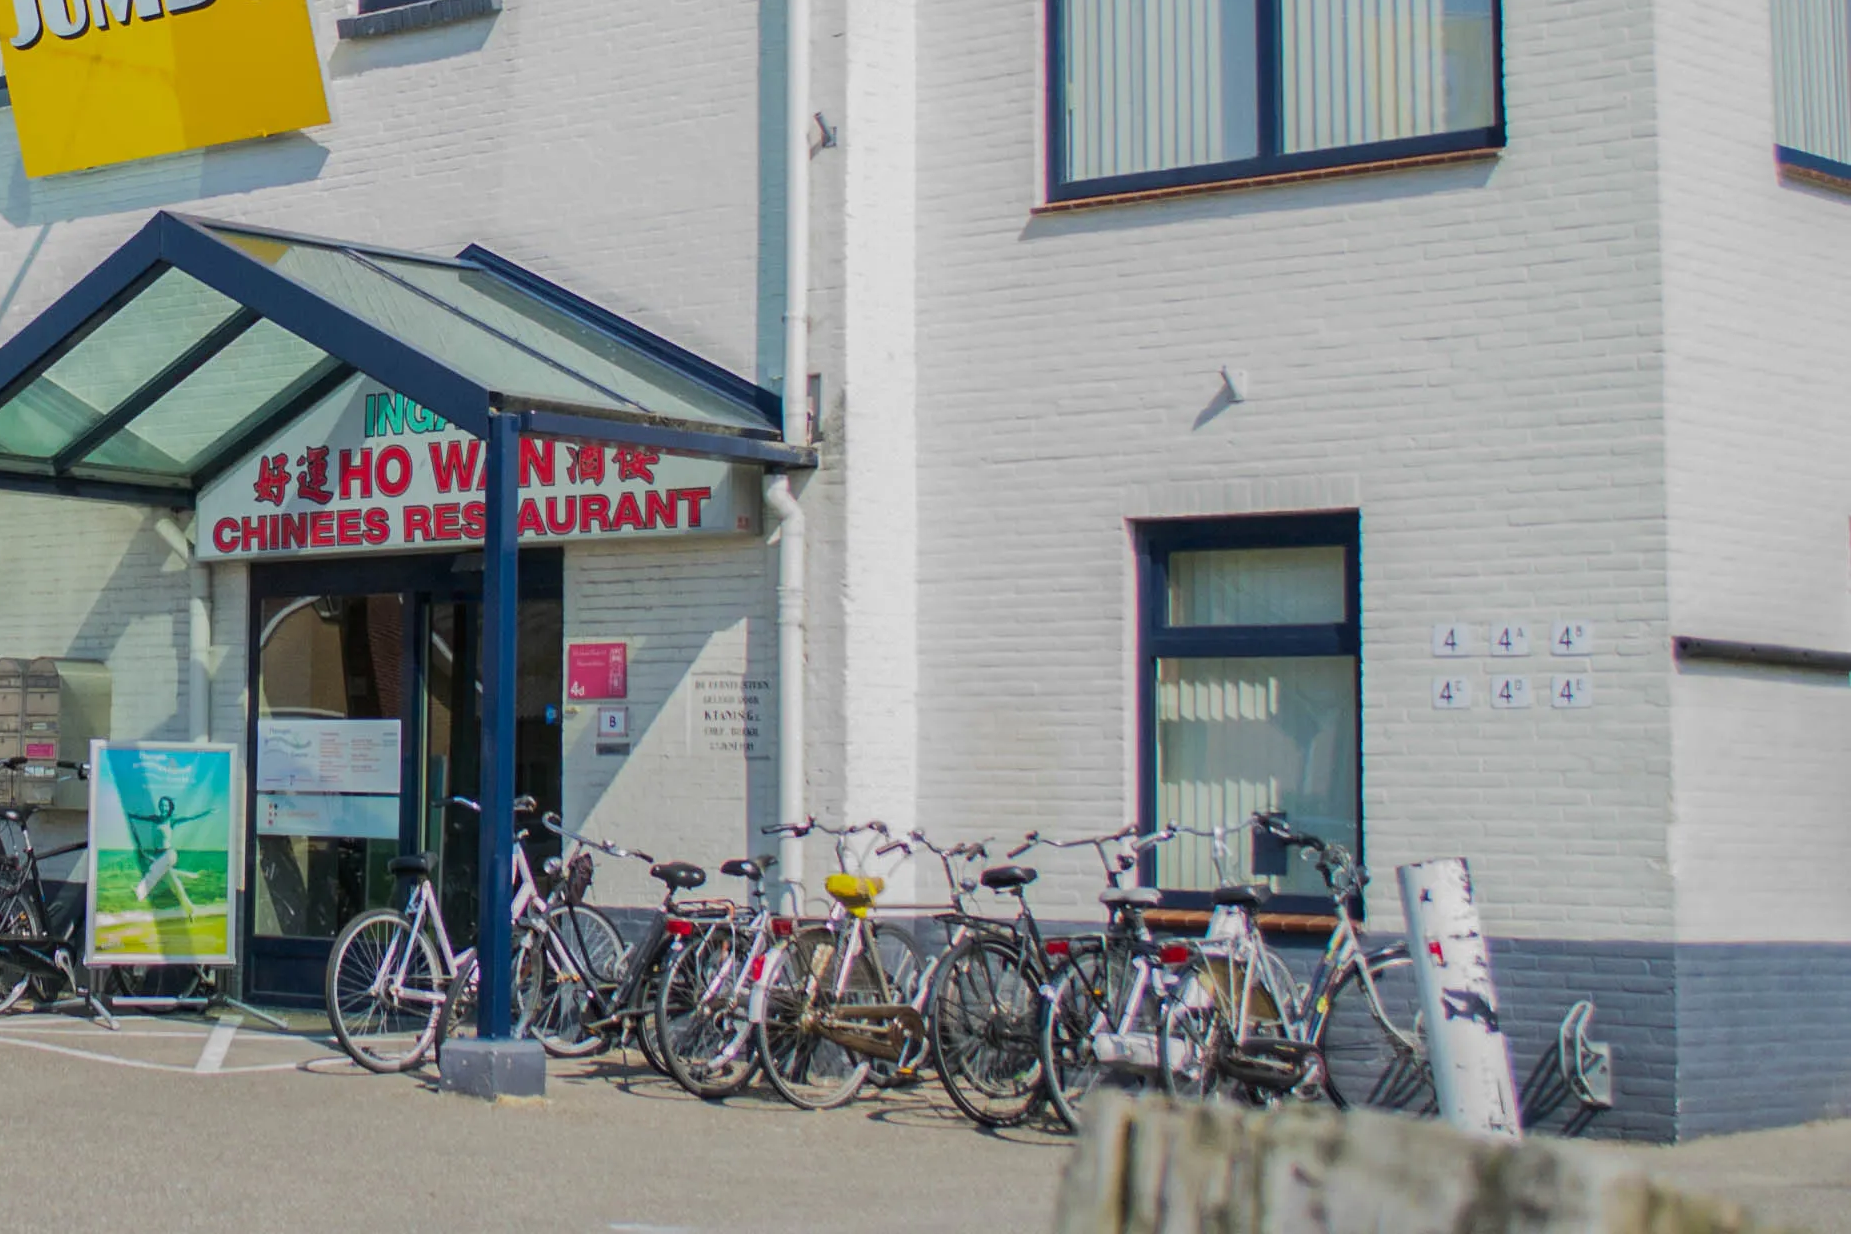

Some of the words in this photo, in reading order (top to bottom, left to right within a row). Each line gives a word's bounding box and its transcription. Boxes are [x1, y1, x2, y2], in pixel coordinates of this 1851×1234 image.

[364, 392, 453, 438] ING
[253, 445, 335, 506] 好運
[339, 444, 413, 500] HO
[428, 437, 556, 494] WN
[212, 508, 391, 553] CHINEES
[403, 486, 711, 543] RESAURANT
[1443, 627, 1457, 651] 4
